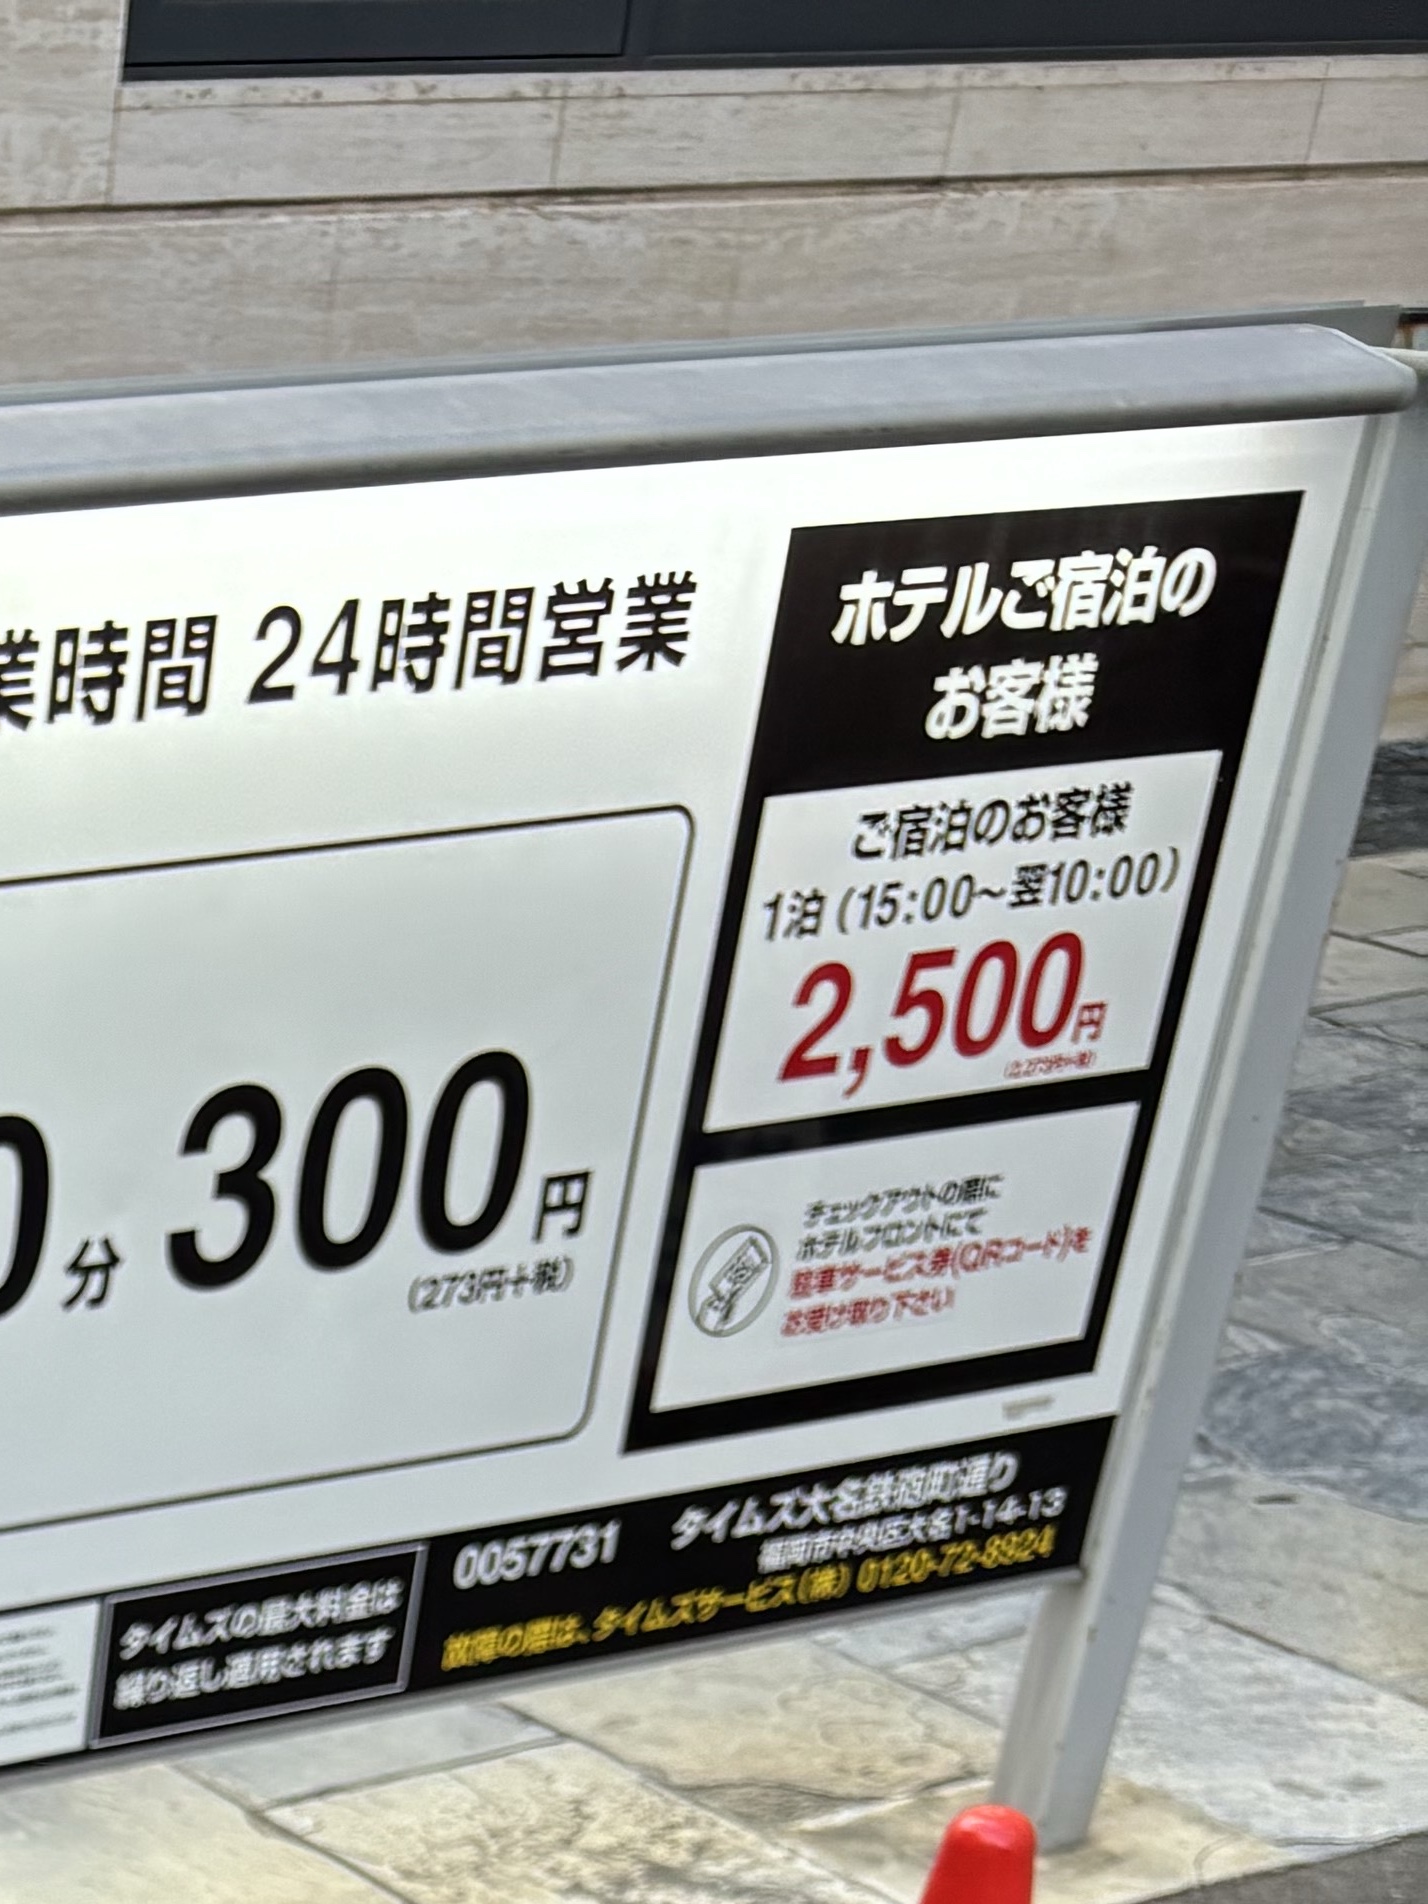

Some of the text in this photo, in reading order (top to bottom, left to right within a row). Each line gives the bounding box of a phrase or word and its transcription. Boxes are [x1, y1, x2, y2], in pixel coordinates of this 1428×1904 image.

[247, 570, 698, 706] 24時間営業
[830, 545, 1219, 646] ホテルご宿泊の
[924, 651, 1100, 740] お客様
[849, 781, 1136, 862] ご宿泊のお客様
[453, 1517, 623, 1591] 0057731
